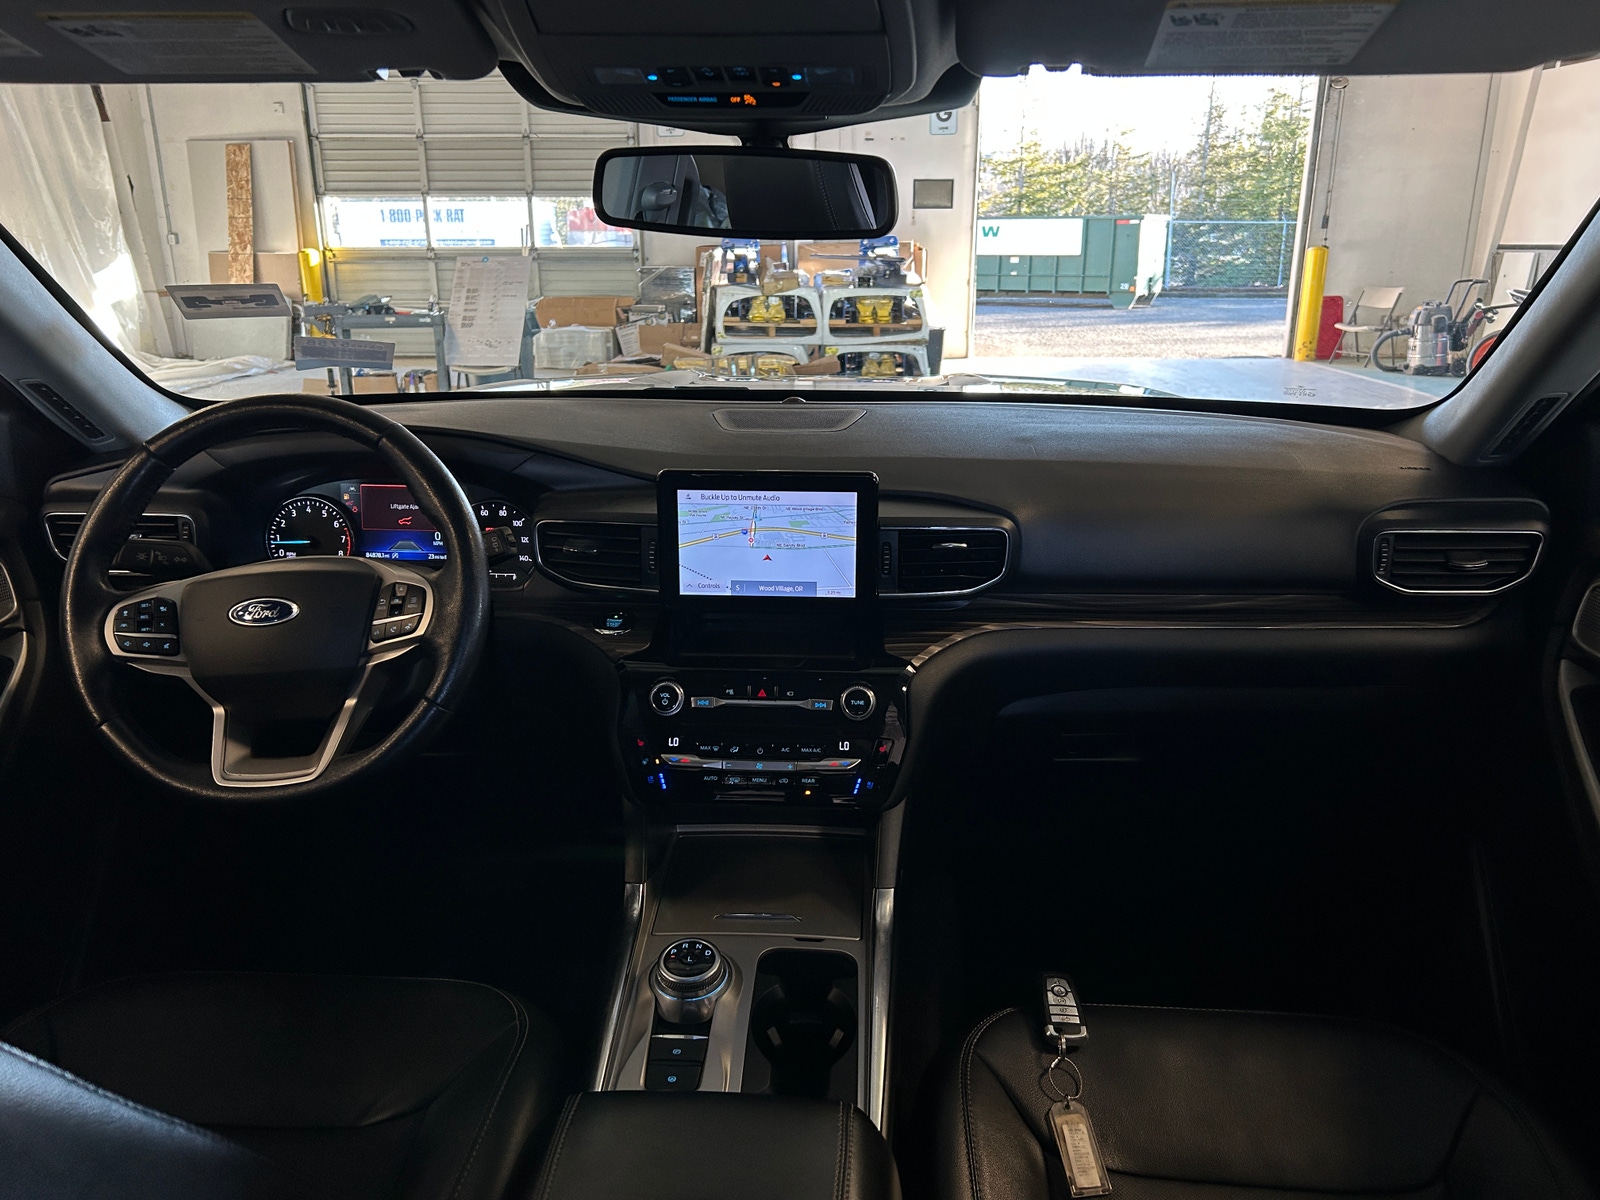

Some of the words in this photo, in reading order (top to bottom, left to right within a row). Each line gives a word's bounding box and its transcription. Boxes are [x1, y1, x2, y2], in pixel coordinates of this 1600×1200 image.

[700, 493, 720, 501] Buckle
[721, 493, 730, 502] Up
[763, 494, 781, 502] Audio
[291, 509, 297, 517] 3
[305, 505, 311, 513] 4
[321, 509, 327, 518] 5
[498, 509, 507, 517] 80
[280, 519, 286, 528] 2
[333, 520, 340, 528] 6
[340, 535, 346, 543] 7
[434, 531, 441, 541] 0
[278, 548, 285, 557] 0
[775, 585, 794, 593] Village,
[243, 603, 280, 620] Ford
[668, 737, 679, 747] LO
[839, 741, 850, 751] LO
